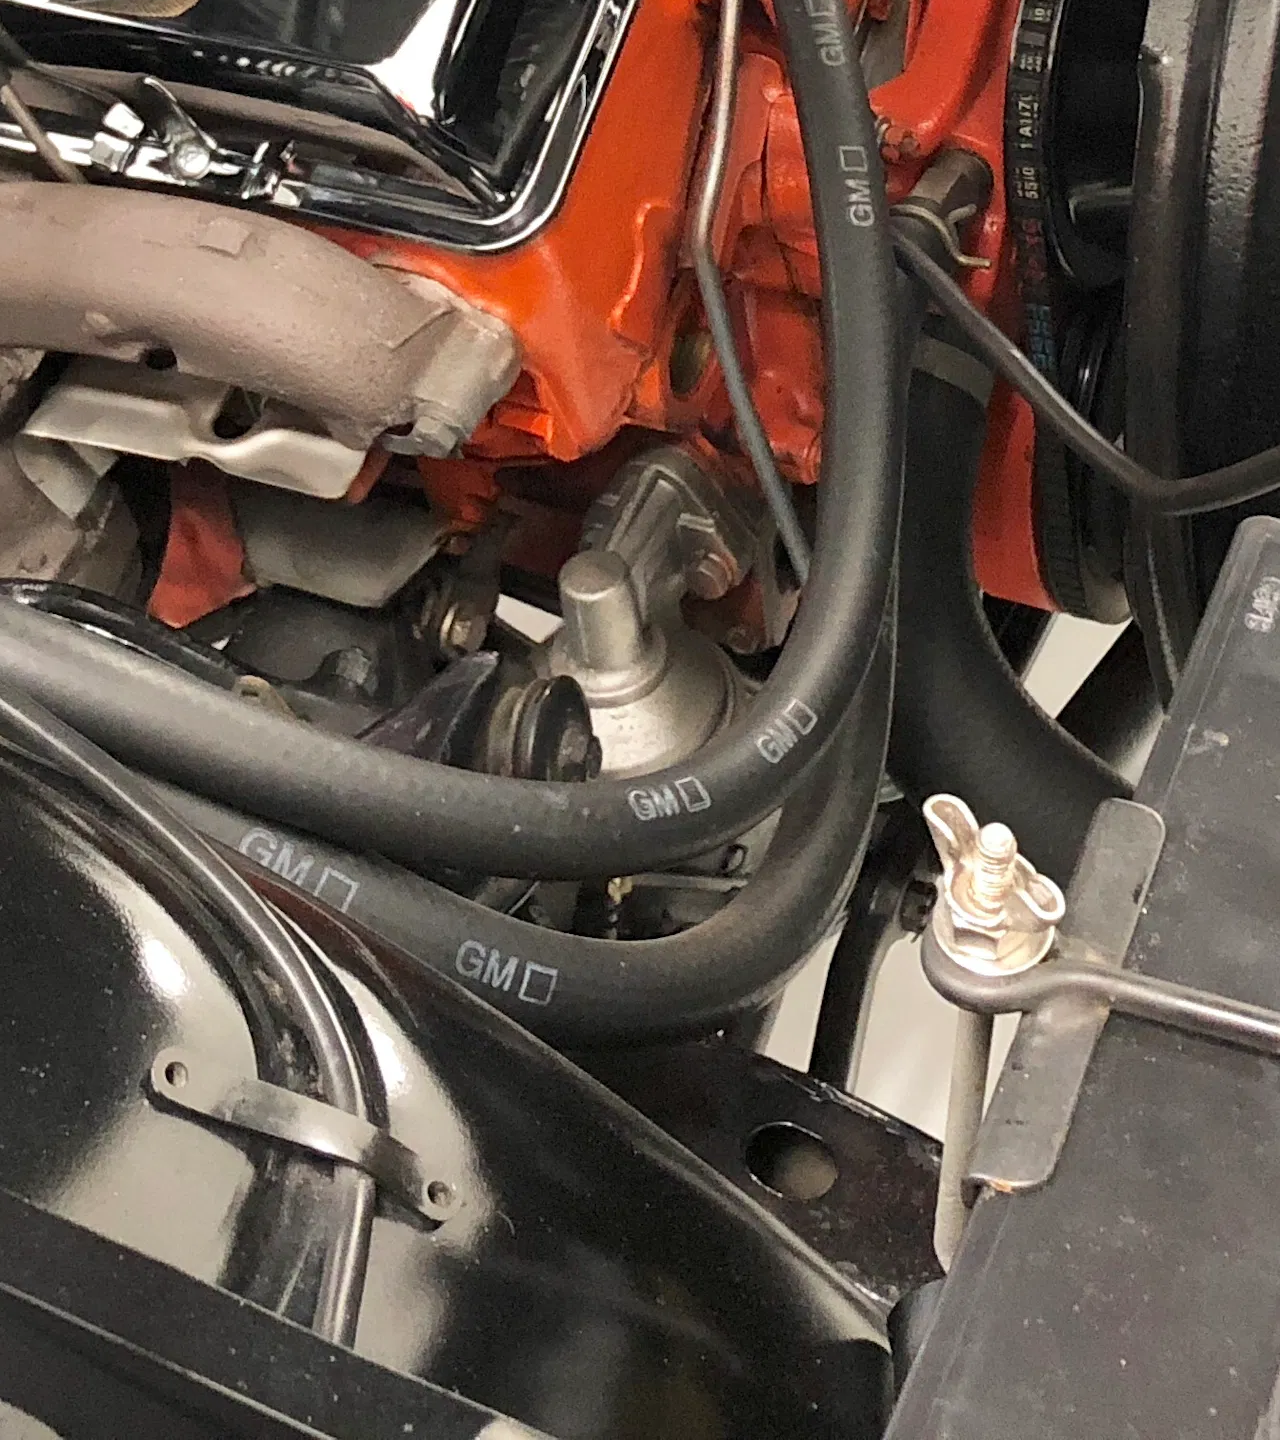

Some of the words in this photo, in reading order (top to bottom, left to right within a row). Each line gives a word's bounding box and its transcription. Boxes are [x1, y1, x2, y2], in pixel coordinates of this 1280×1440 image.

[816, 22, 845, 67] GM
[844, 177, 876, 227] GM
[754, 720, 799, 763] GM
[627, 784, 678, 821] GM
[238, 827, 317, 888] GM
[455, 939, 520, 994] GM
